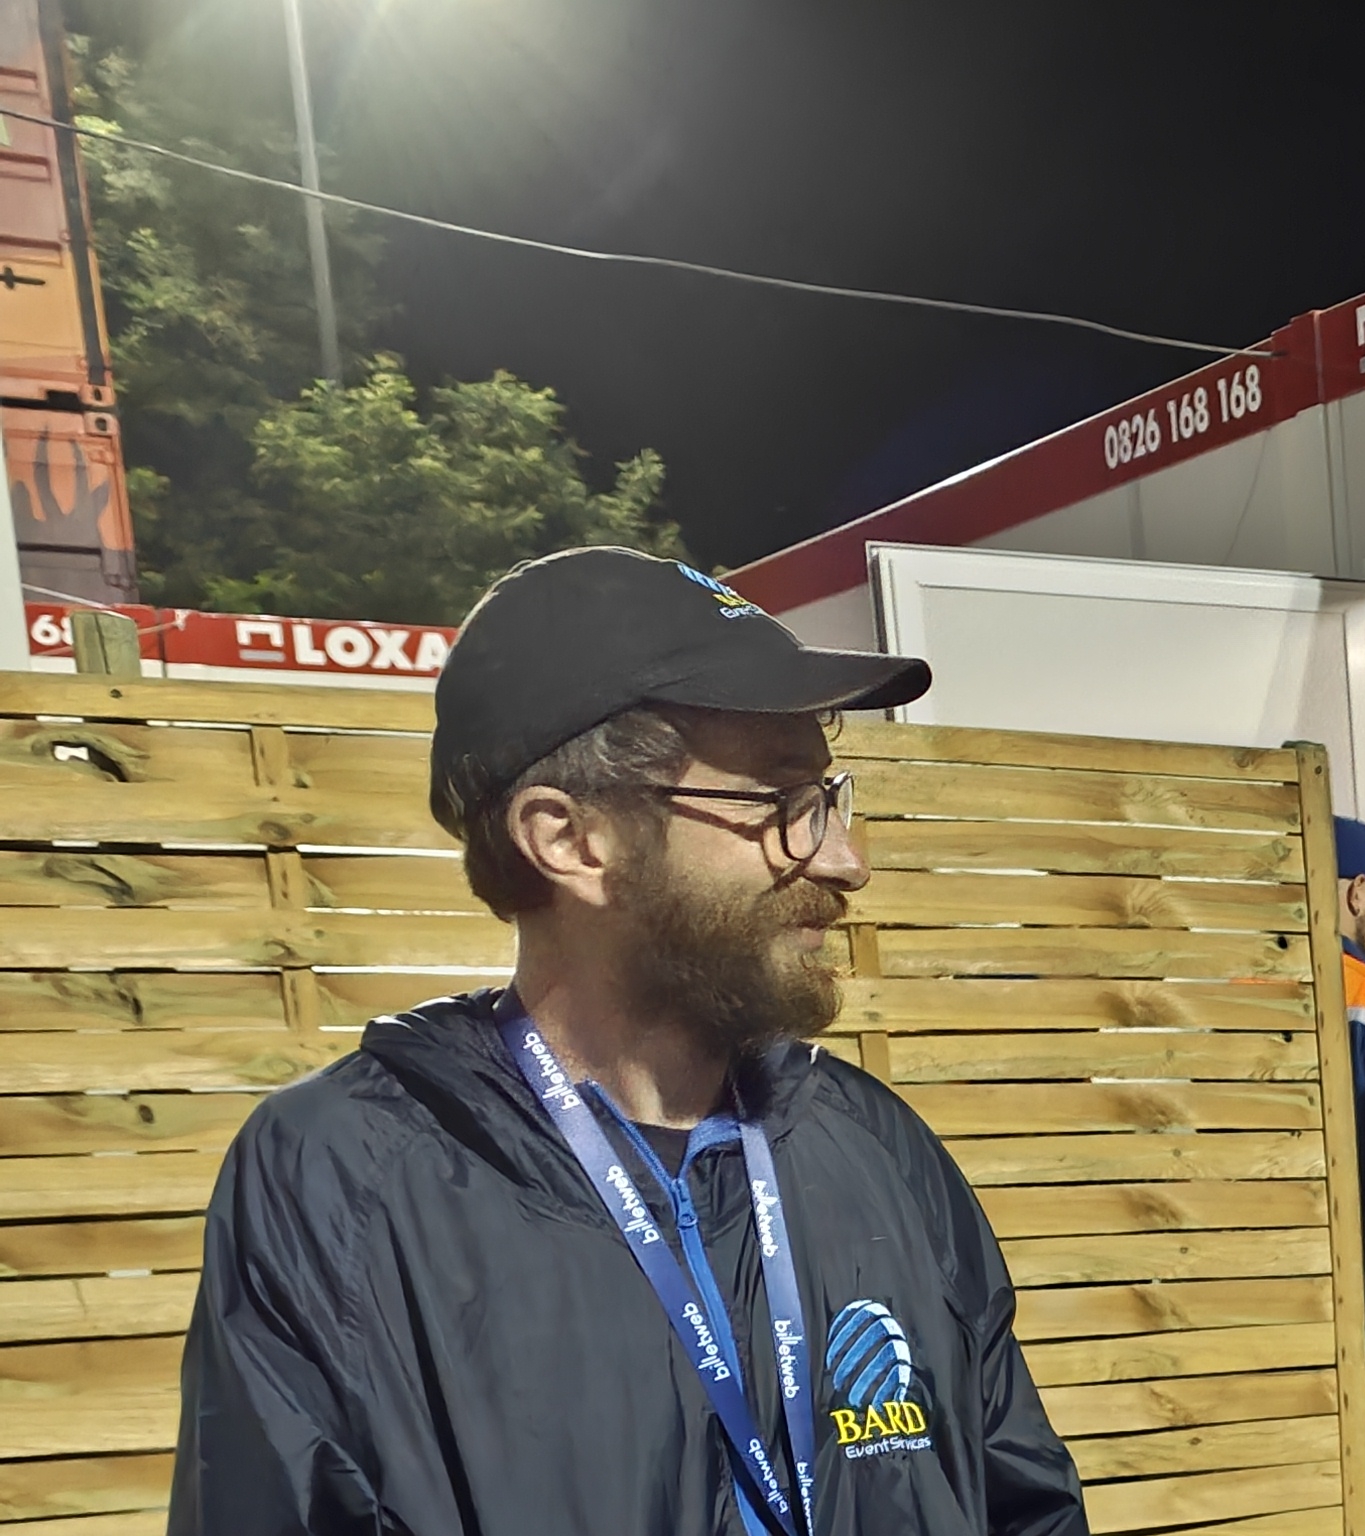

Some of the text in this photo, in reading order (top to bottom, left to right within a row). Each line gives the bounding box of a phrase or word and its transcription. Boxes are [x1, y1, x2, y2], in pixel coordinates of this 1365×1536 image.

[1104, 363, 1263, 469] 0826 168 168
[291, 623, 450, 672] LOXA
[522, 1031, 581, 1110] billetweb
[606, 1164, 661, 1246] billetweb
[684, 1301, 733, 1382] billetweb
[774, 1319, 801, 1400] billetweb
[830, 1401, 926, 1444] BARD
[748, 1437, 788, 1516] billetweb
